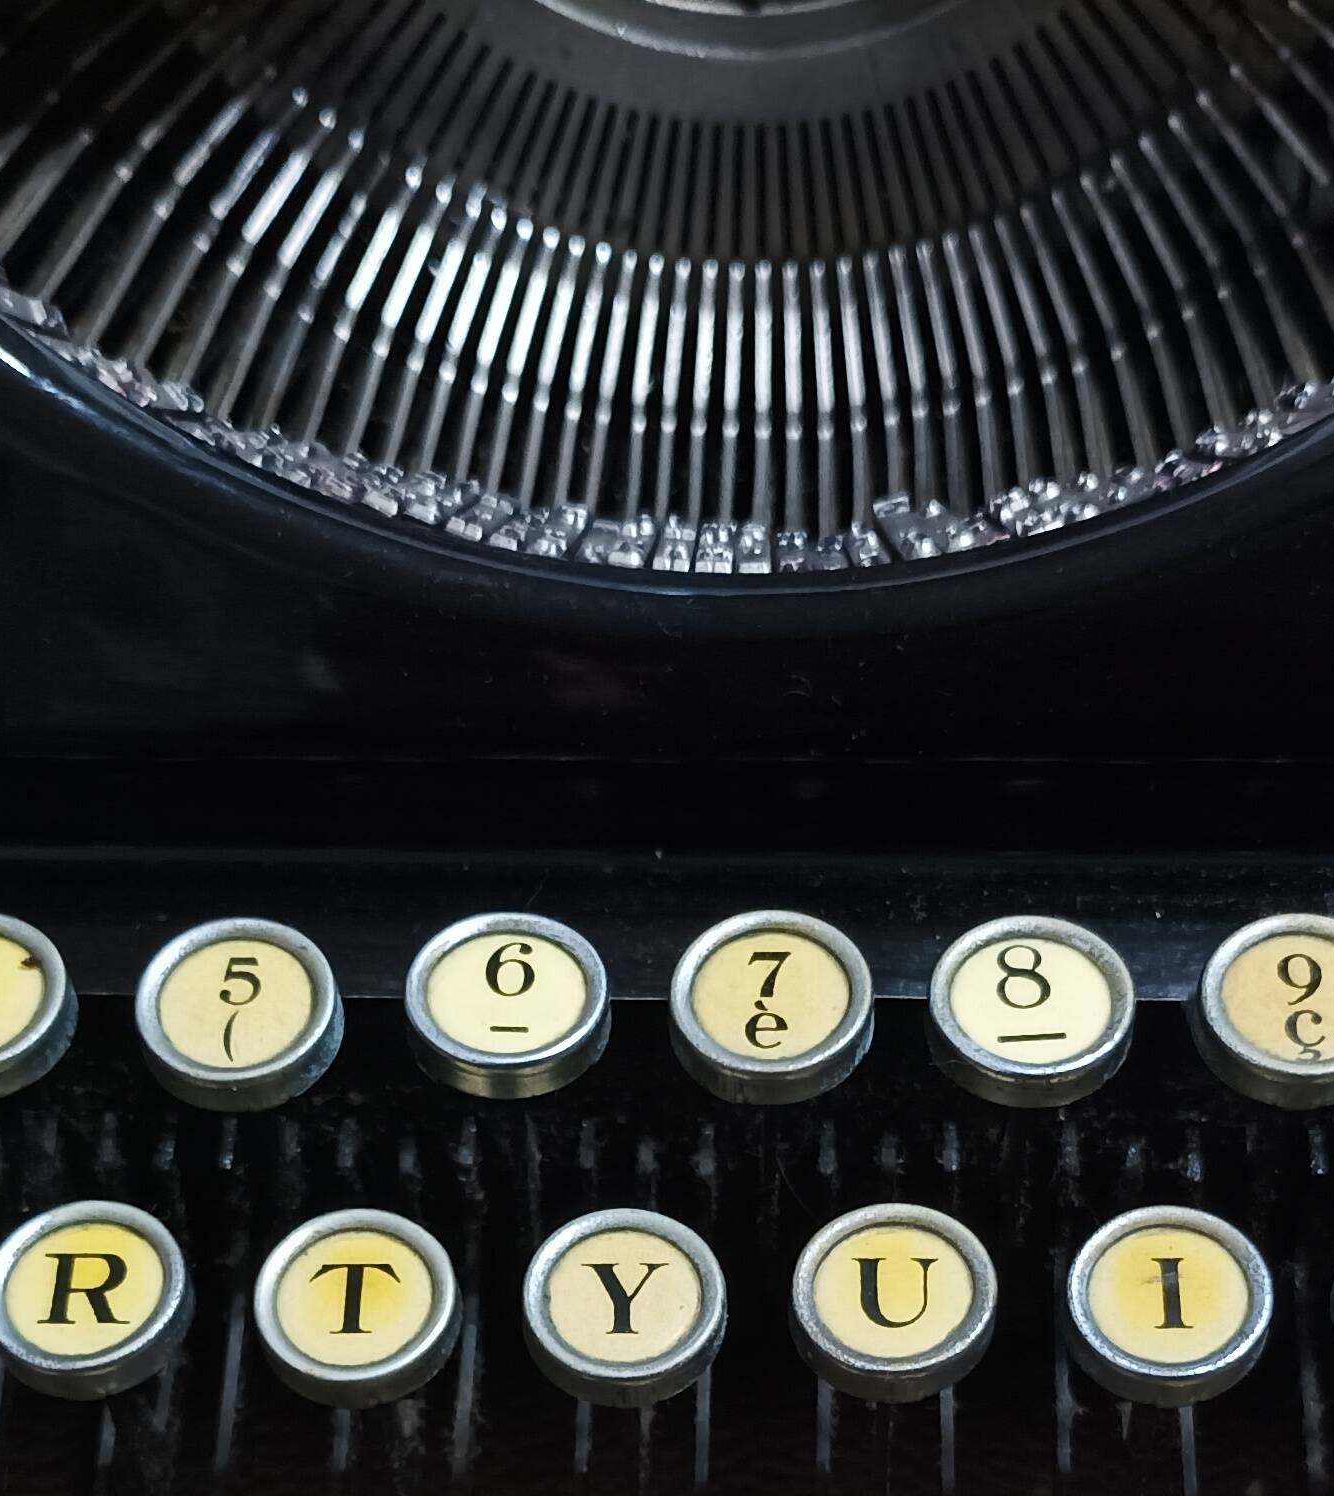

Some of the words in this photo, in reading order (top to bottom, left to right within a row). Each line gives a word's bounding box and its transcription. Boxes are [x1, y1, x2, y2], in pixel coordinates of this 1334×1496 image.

[220, 957, 261, 1005] 5
[486, 943, 535, 996] 6
[748, 952, 791, 997] 7
[997, 945, 1051, 1009] 8
[1277, 954, 1322, 1005] 9
[745, 1000, 788, 1049] è
[1283, 1009, 1327, 1062] ç
[37, 1253, 130, 1324] R
[310, 1264, 400, 1334] T
[582, 1263, 669, 1334] Y
[852, 1258, 938, 1328] U
[1151, 1258, 1193, 1329] I
